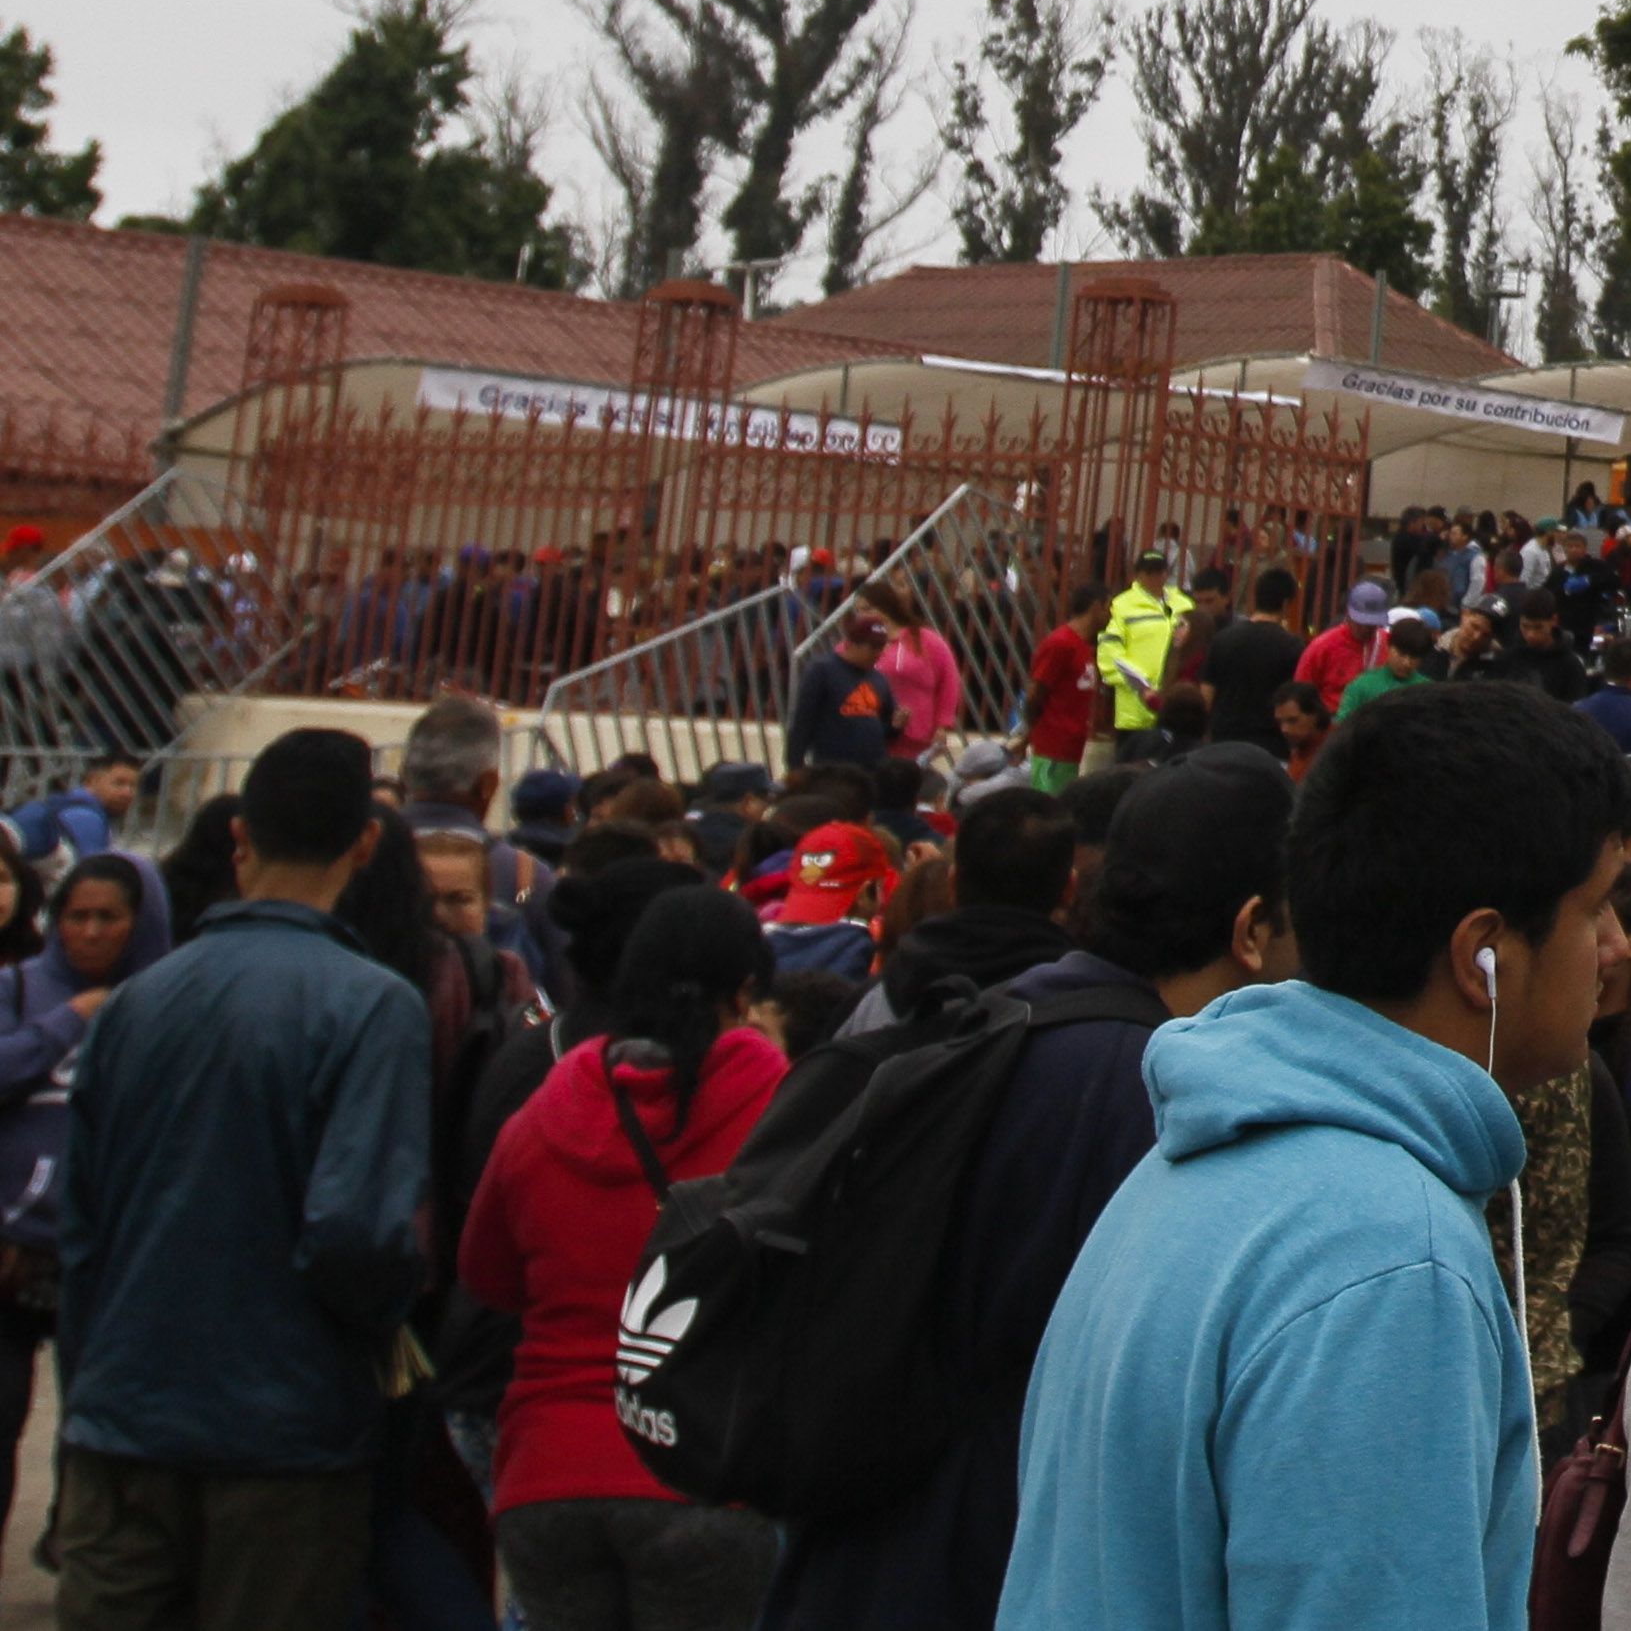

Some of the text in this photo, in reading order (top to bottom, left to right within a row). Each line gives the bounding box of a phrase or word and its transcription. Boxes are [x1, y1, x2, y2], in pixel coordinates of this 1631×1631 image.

[1342, 373, 1590, 432] Gracias por su contribución
